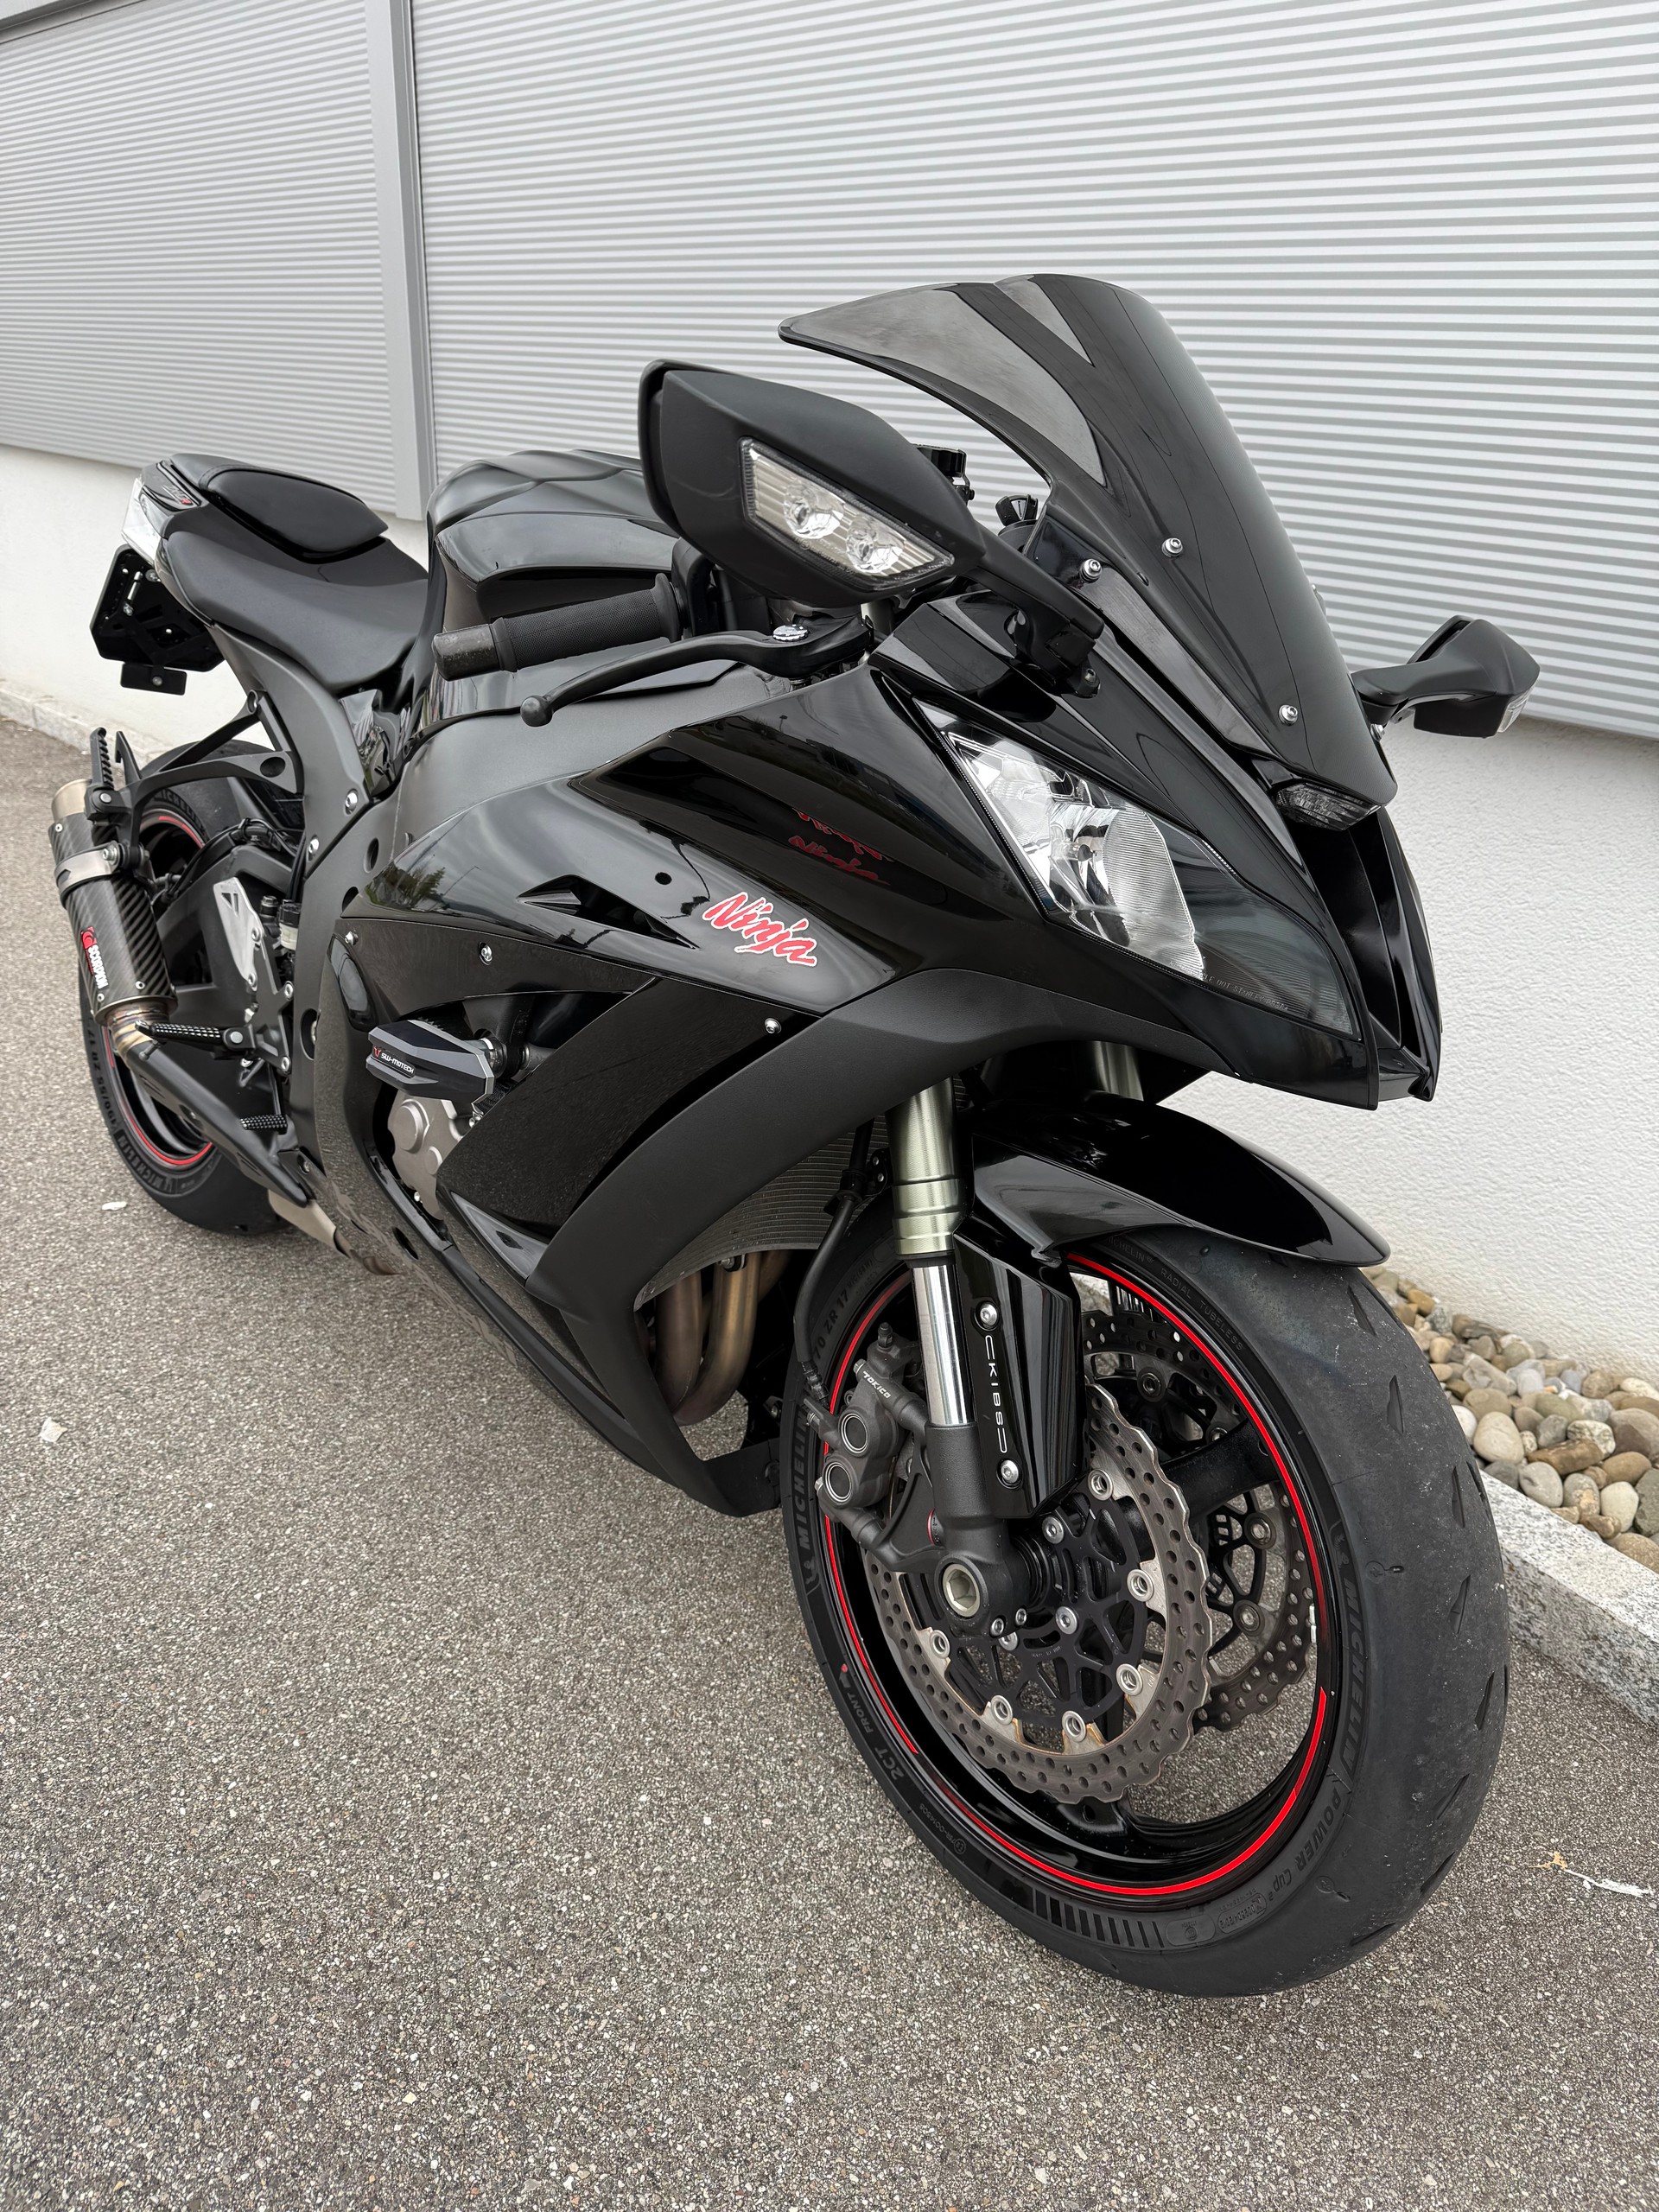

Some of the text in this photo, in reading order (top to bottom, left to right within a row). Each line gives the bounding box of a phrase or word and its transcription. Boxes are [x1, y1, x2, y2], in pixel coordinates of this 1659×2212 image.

[702, 892, 818, 967] Ninja
[88, 944, 109, 989] SCORPION
[380, 1052, 415, 1074] SW-MOTECH
[823, 1309, 838, 1334] ZR
[836, 1288, 849, 1309] 17
[1160, 1268, 1192, 1300] RADIAL
[1200, 1300, 1244, 1351] TUBELESS
[862, 1370, 892, 1399] TOKICO
[792, 1409, 811, 1551] MICHELIN
[1343, 1577, 1365, 1773] MICHELIN
[847, 1692, 874, 1733] FRONT
[874, 1746, 906, 1780] 2CT
[1295, 1787, 1341, 1872] POWER
